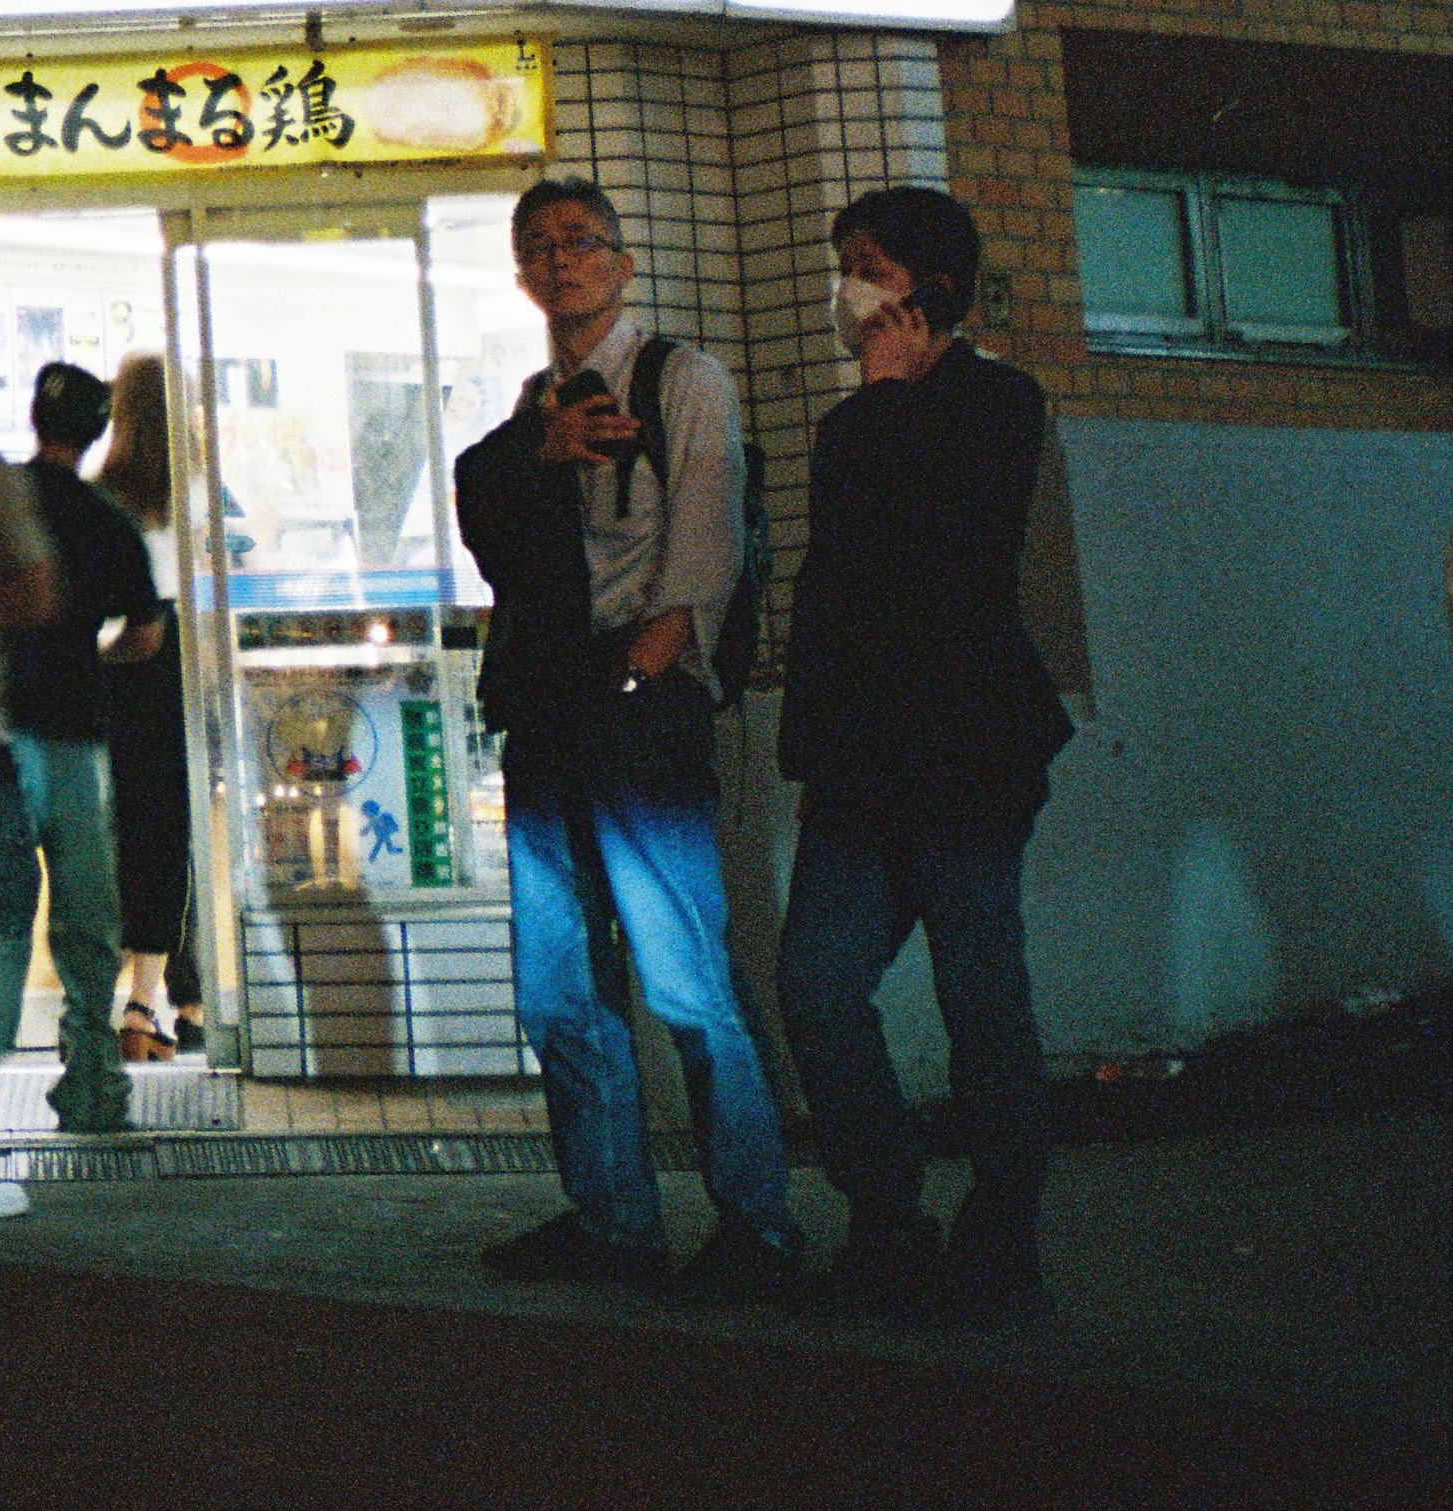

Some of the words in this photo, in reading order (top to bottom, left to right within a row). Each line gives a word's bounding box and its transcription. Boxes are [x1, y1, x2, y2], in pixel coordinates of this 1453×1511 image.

[2, 60, 356, 153] まんまる鶏
